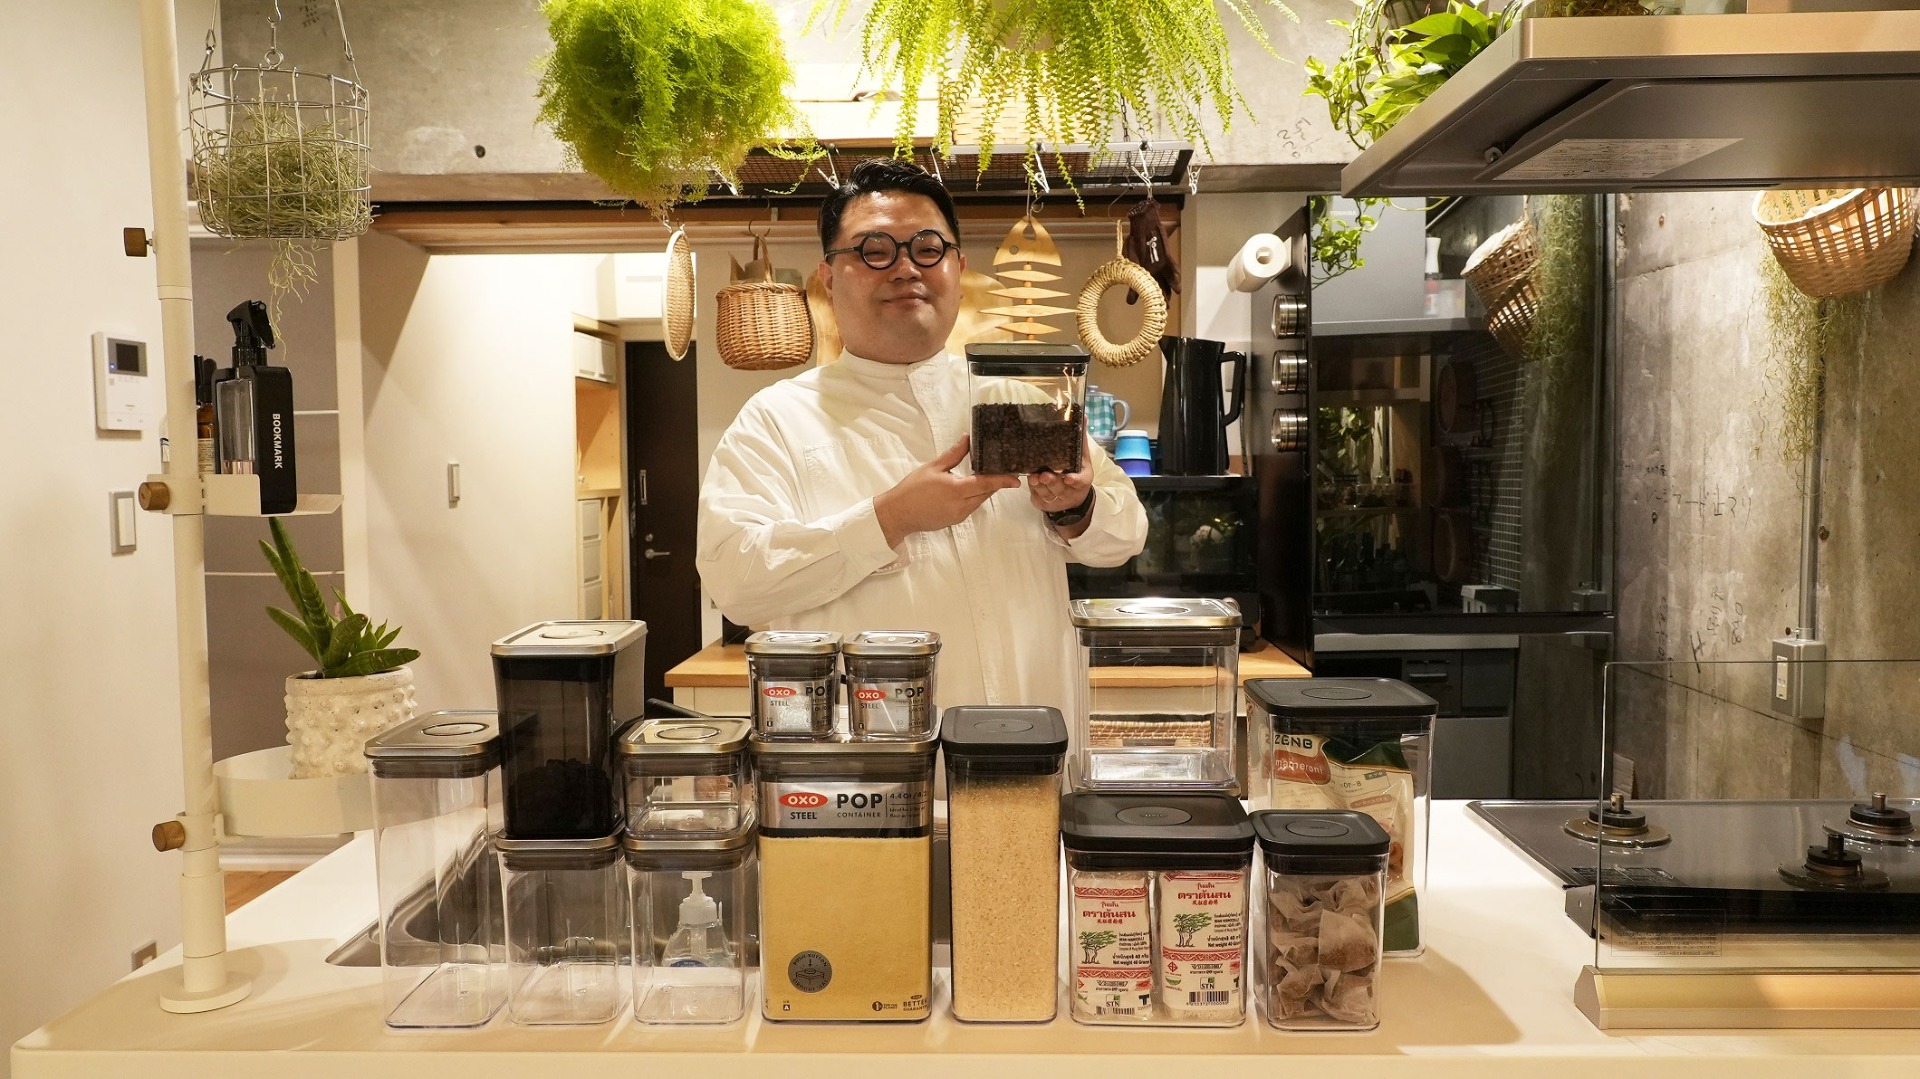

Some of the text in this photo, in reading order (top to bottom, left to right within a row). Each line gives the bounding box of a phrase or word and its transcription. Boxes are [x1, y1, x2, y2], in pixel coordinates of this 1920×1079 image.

[272, 413, 283, 469] BOOKMARK
[805, 685, 831, 697] POP
[858, 691, 880, 699] OXO
[894, 686, 925, 699] POP
[1275, 734, 1313, 749] ZENB
[787, 795, 819, 805] OXO
[836, 793, 883, 809] POP
[790, 811, 818, 820] STEEL
